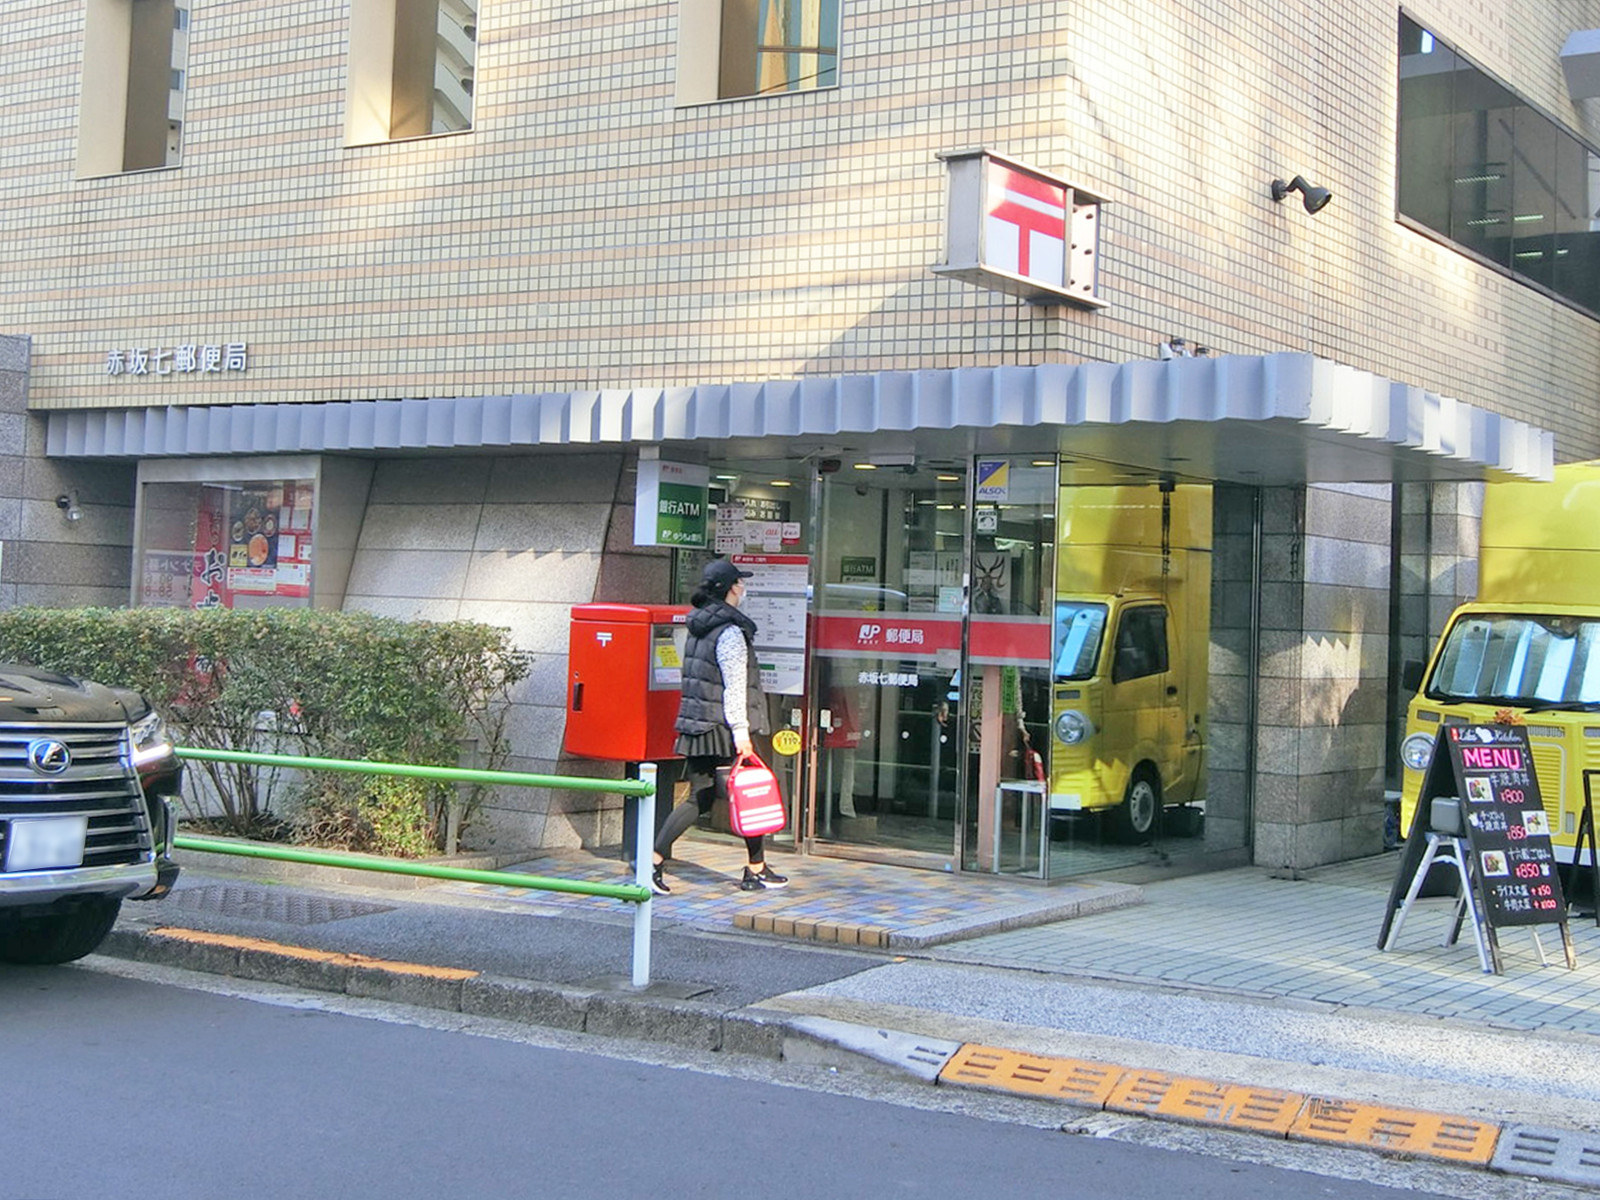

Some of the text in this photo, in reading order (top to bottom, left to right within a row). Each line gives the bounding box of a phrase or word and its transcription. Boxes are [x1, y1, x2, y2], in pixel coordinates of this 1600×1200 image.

[106, 342, 247, 376] 赤坂七郵便局
[659, 500, 700, 516] 銀行ATM
[885, 628, 924, 645] 郵便局
[857, 671, 919, 687] 赤坂七郵便局
[1462, 747, 1520, 770] MENU
[1500, 789, 1524, 804] ¥800
[1516, 863, 1540, 878] ¥850
